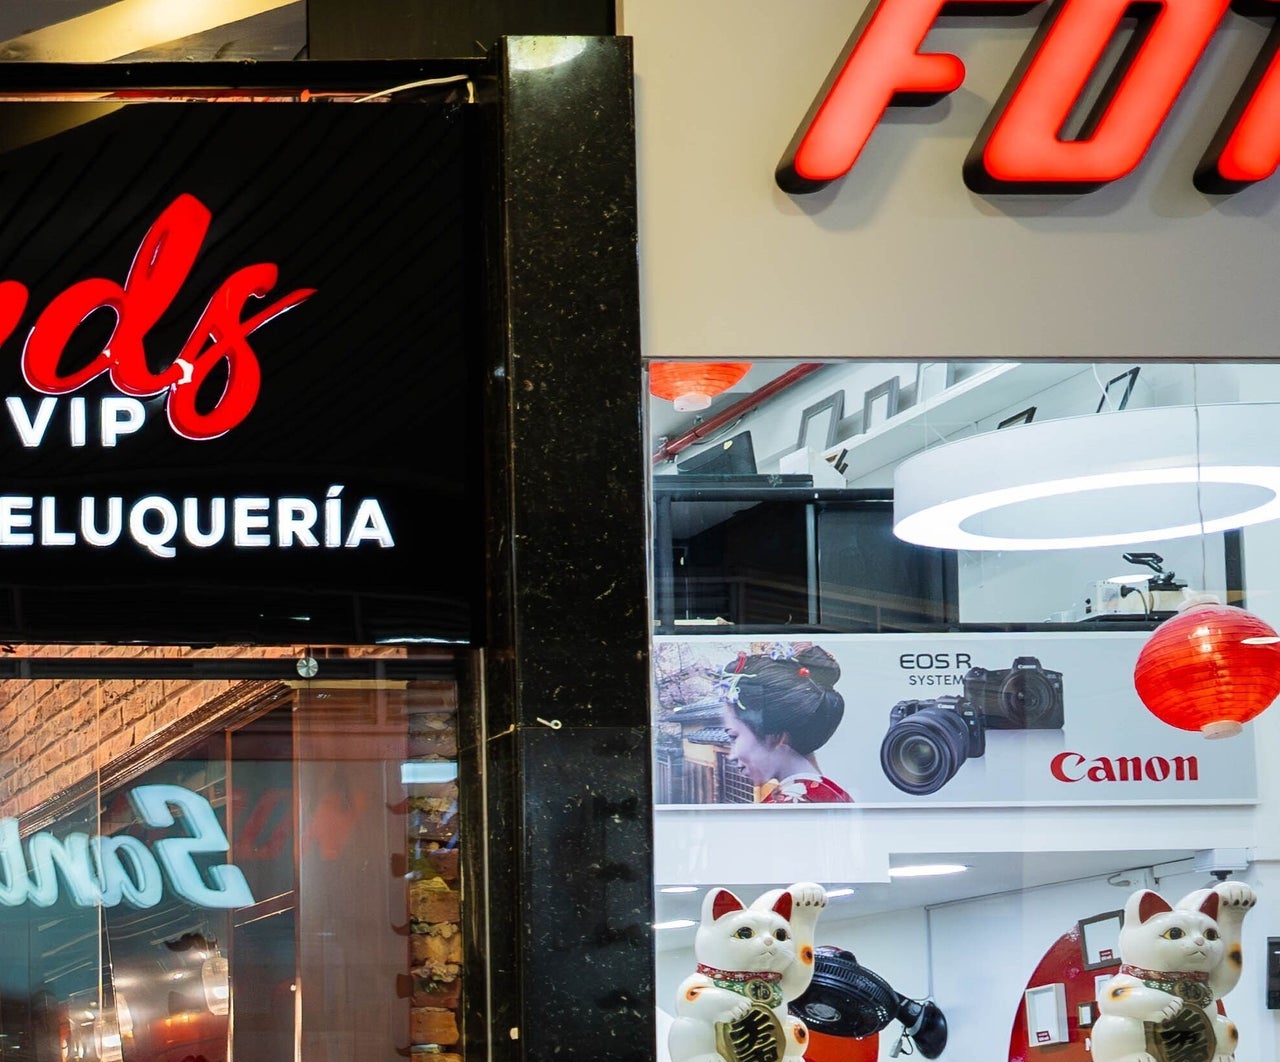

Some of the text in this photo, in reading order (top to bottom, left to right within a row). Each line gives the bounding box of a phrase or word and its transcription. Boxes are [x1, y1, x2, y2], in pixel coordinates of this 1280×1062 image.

[5, 397, 150, 448] VIP
[900, 653, 972, 670] EOS R
[908, 674, 964, 686] SYSTEM
[1050, 751, 1199, 783] Canon
